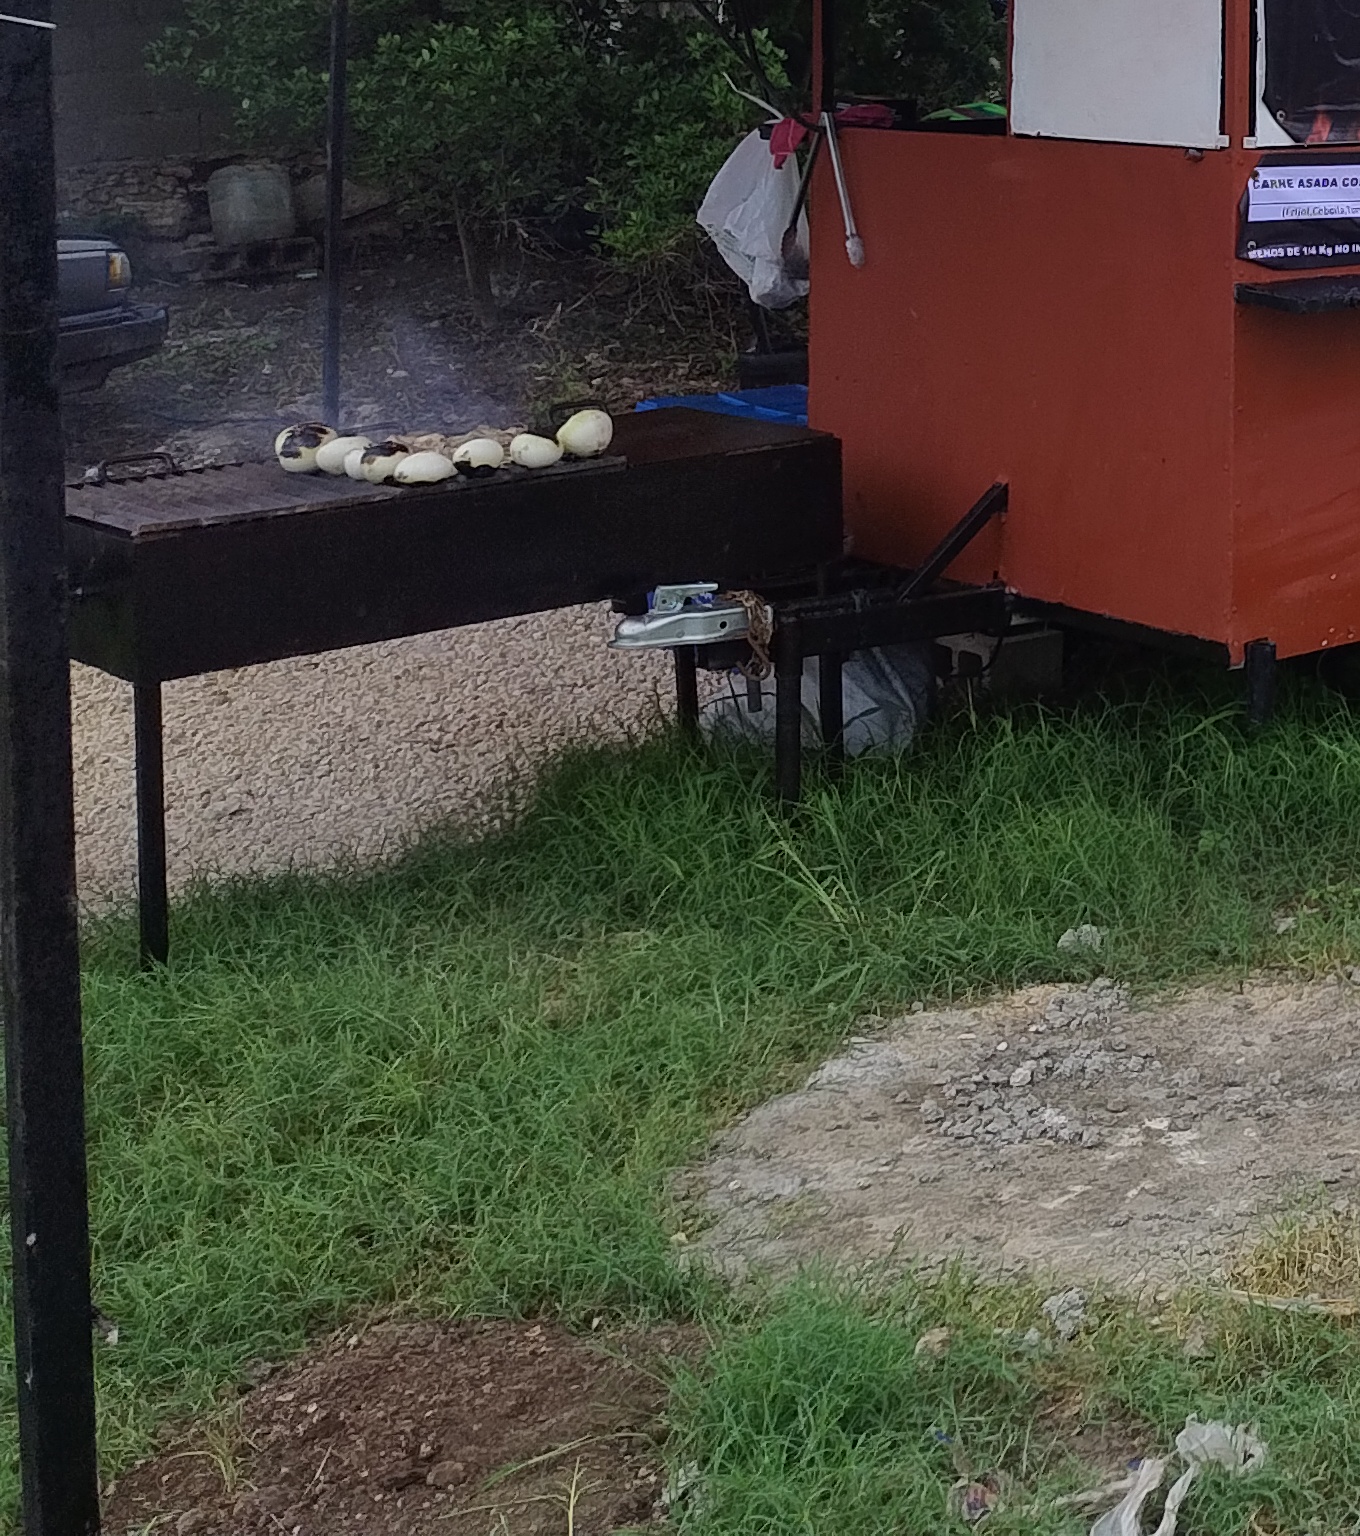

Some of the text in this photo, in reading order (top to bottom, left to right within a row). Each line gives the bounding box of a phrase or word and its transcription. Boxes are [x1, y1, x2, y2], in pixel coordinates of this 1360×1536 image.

[1252, 178, 1294, 190] CARNE
[1297, 176, 1339, 189] ASADA
[1286, 247, 1300, 257] DE
[1302, 245, 1317, 256] 1/4
[1319, 244, 1333, 257] Kg
[1334, 243, 1350, 254] NO
